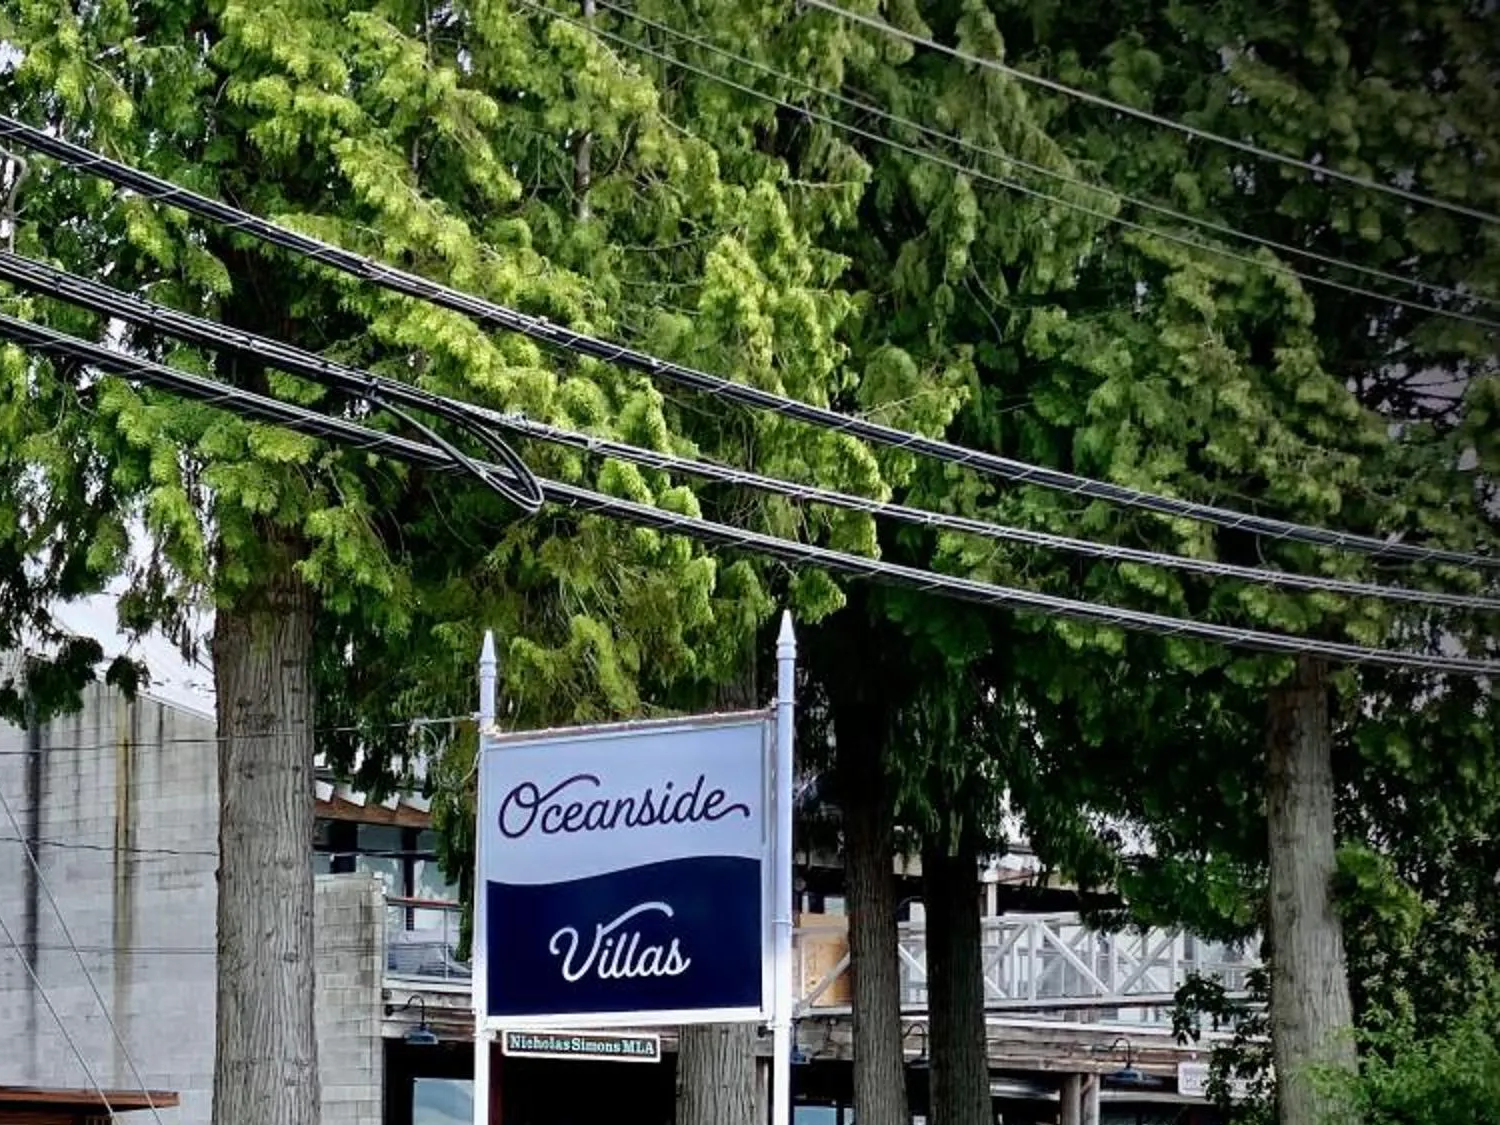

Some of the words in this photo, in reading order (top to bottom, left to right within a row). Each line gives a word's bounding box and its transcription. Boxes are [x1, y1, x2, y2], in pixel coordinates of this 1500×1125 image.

[499, 774, 750, 839] Oceanside
[549, 902, 691, 982] Villas
[509, 1034, 570, 1051] Nicholas
[571, 1037, 621, 1052] Simons
[622, 1040, 655, 1055] MLA
